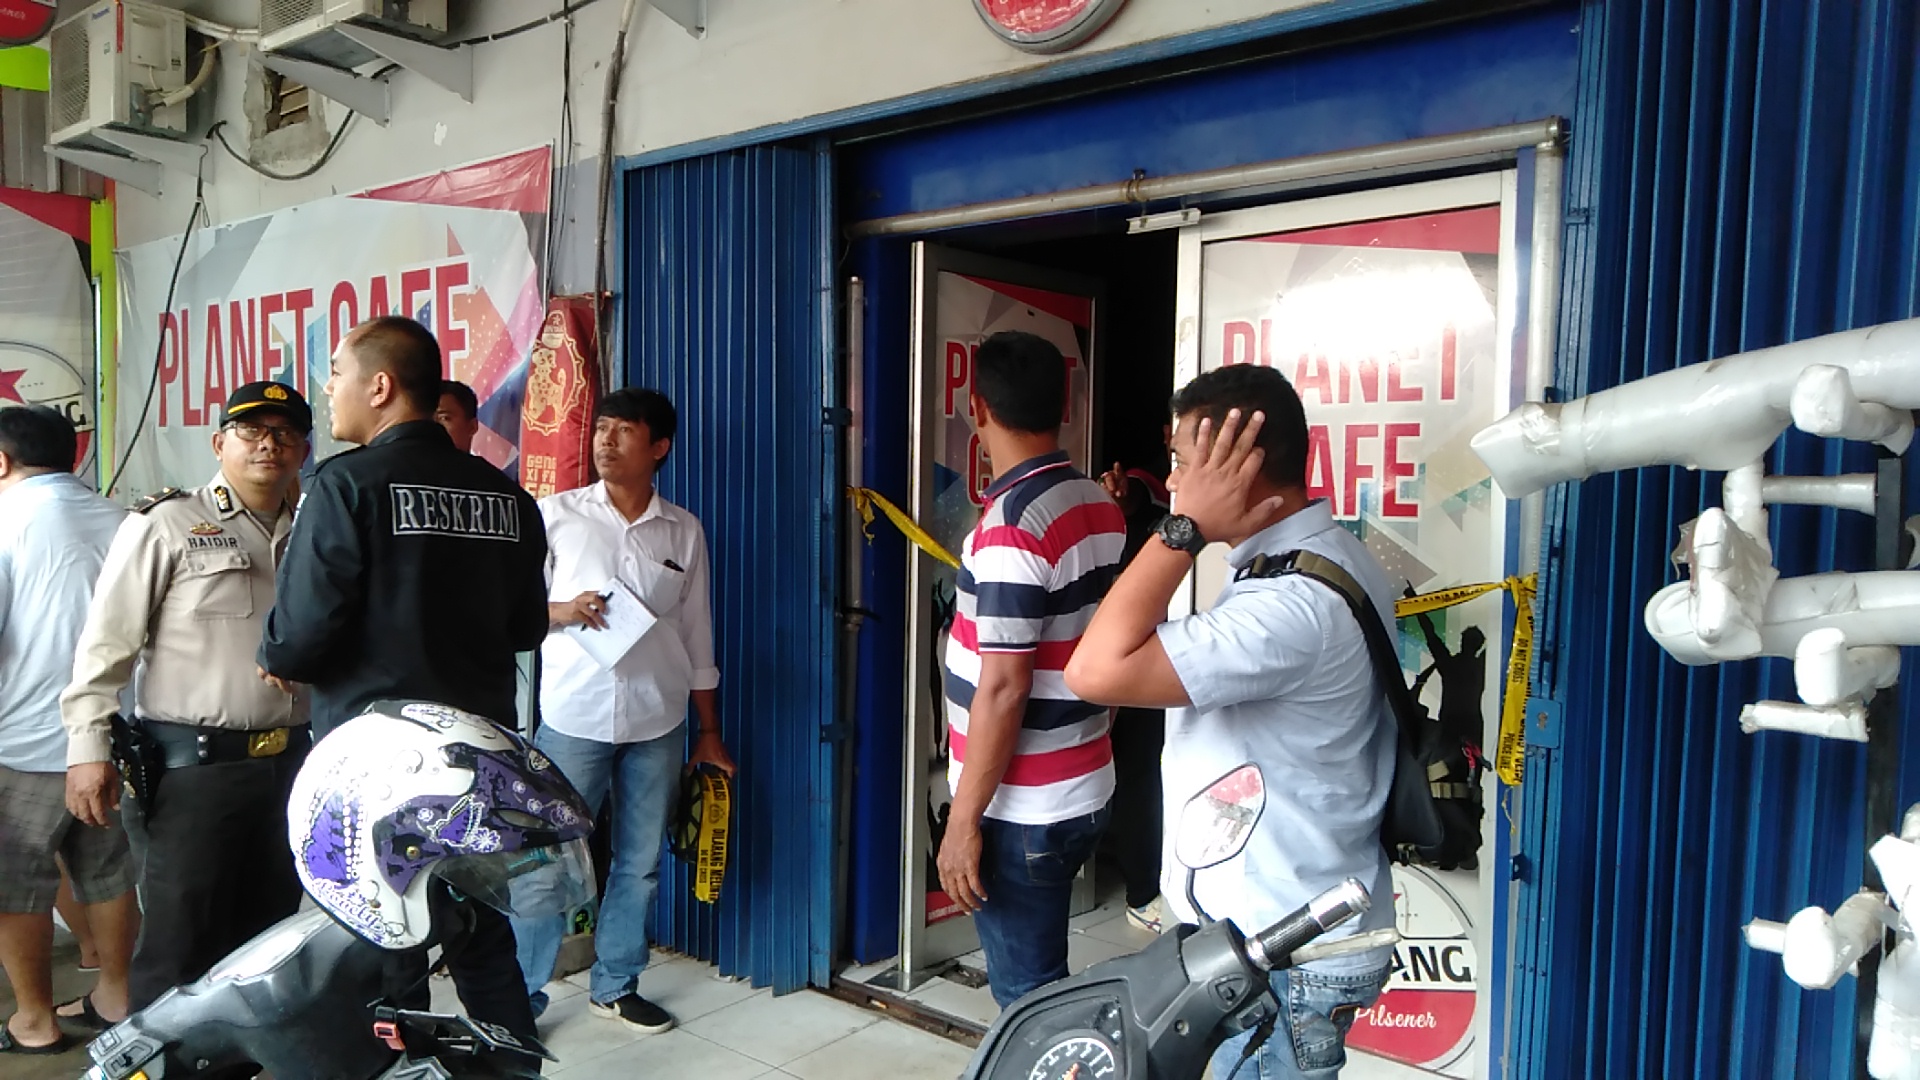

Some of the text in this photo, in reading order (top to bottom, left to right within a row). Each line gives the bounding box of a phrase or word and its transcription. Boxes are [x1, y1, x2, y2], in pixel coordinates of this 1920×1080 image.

[158, 288, 313, 428] PLANET
[1305, 423, 1421, 517] AFE
[396, 488, 516, 537] RESKRIM
[187, 537, 238, 549] HAIDIR
[1517, 637, 1529, 649] DO
[1515, 649, 1528, 663] NOT
[1512, 664, 1526, 684] CROSS
[1501, 732, 1516, 755] POLICE
[710, 828, 726, 868] DILARANG
